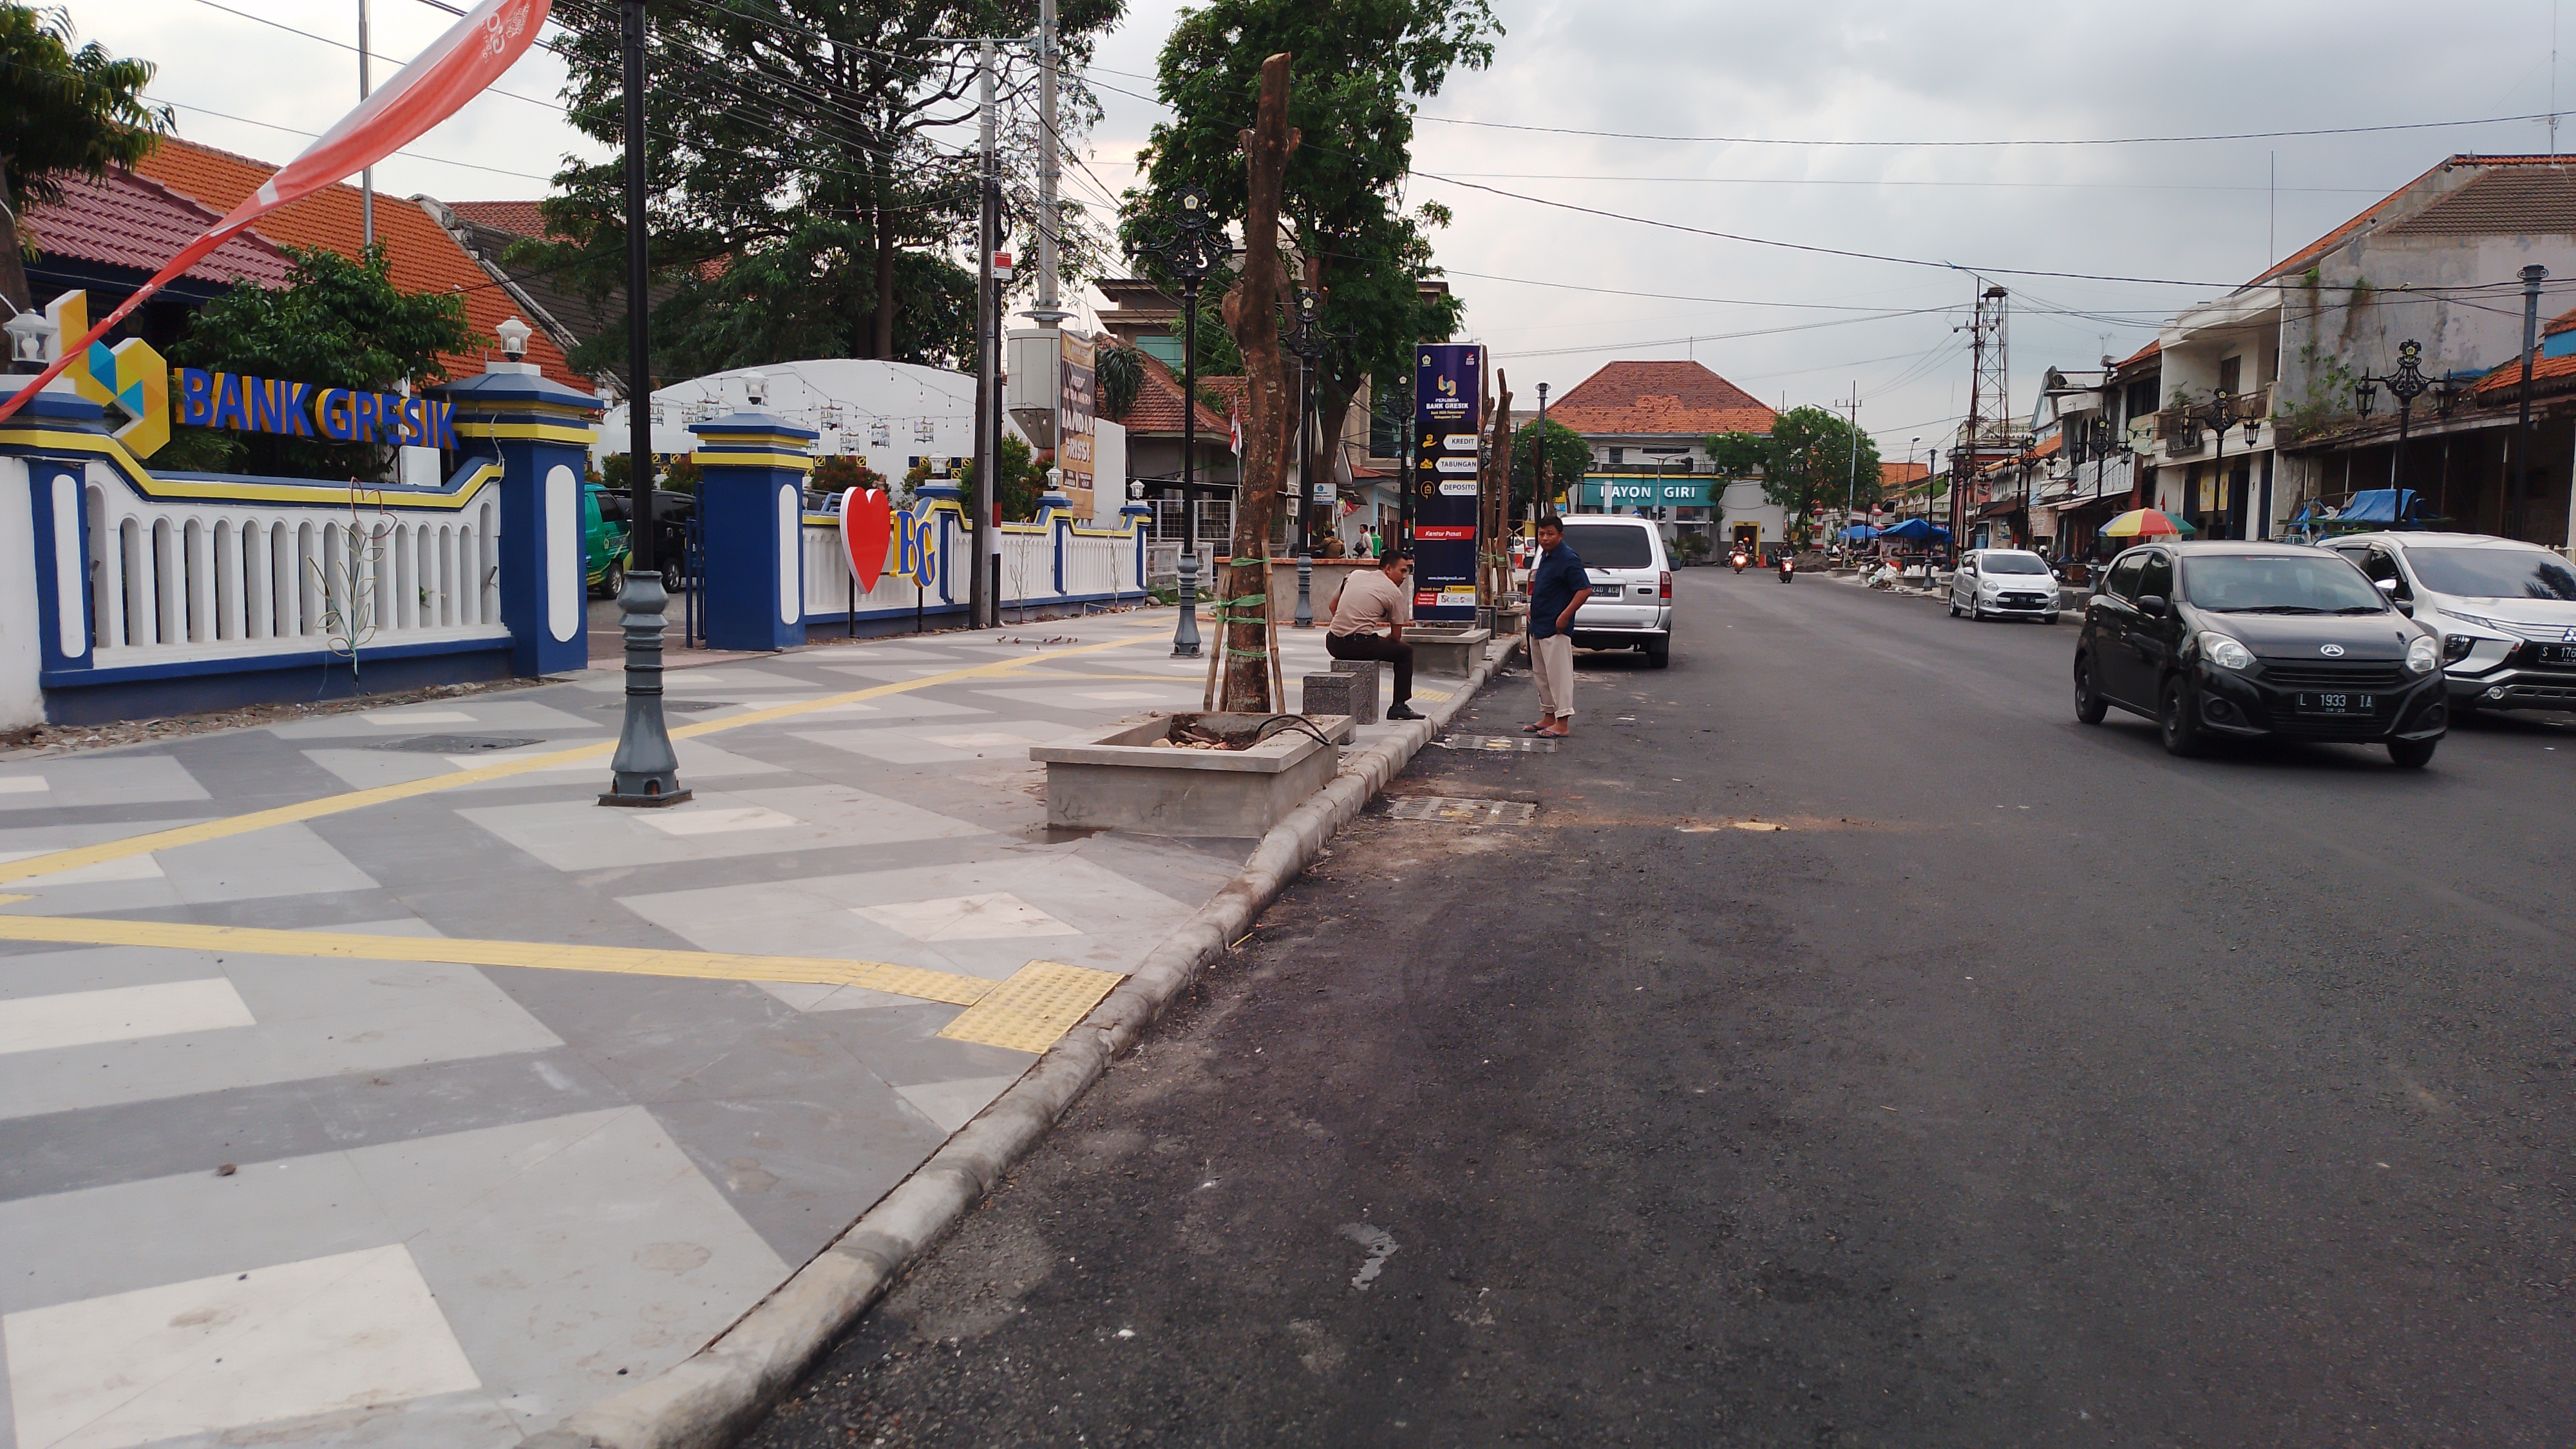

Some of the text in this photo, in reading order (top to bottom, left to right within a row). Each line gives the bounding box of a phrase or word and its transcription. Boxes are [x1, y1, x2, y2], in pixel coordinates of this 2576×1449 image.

[1064, 387, 1077, 401] ULRA
[178, 368, 461, 450] BANK GRESIK
[1062, 407, 1094, 437] BANDAR
[1664, 486, 1696, 498] GIRI
[893, 511, 937, 587] BG
[2542, 647, 2549, 657] S
[2299, 693, 2372, 708] L 1933 IA
